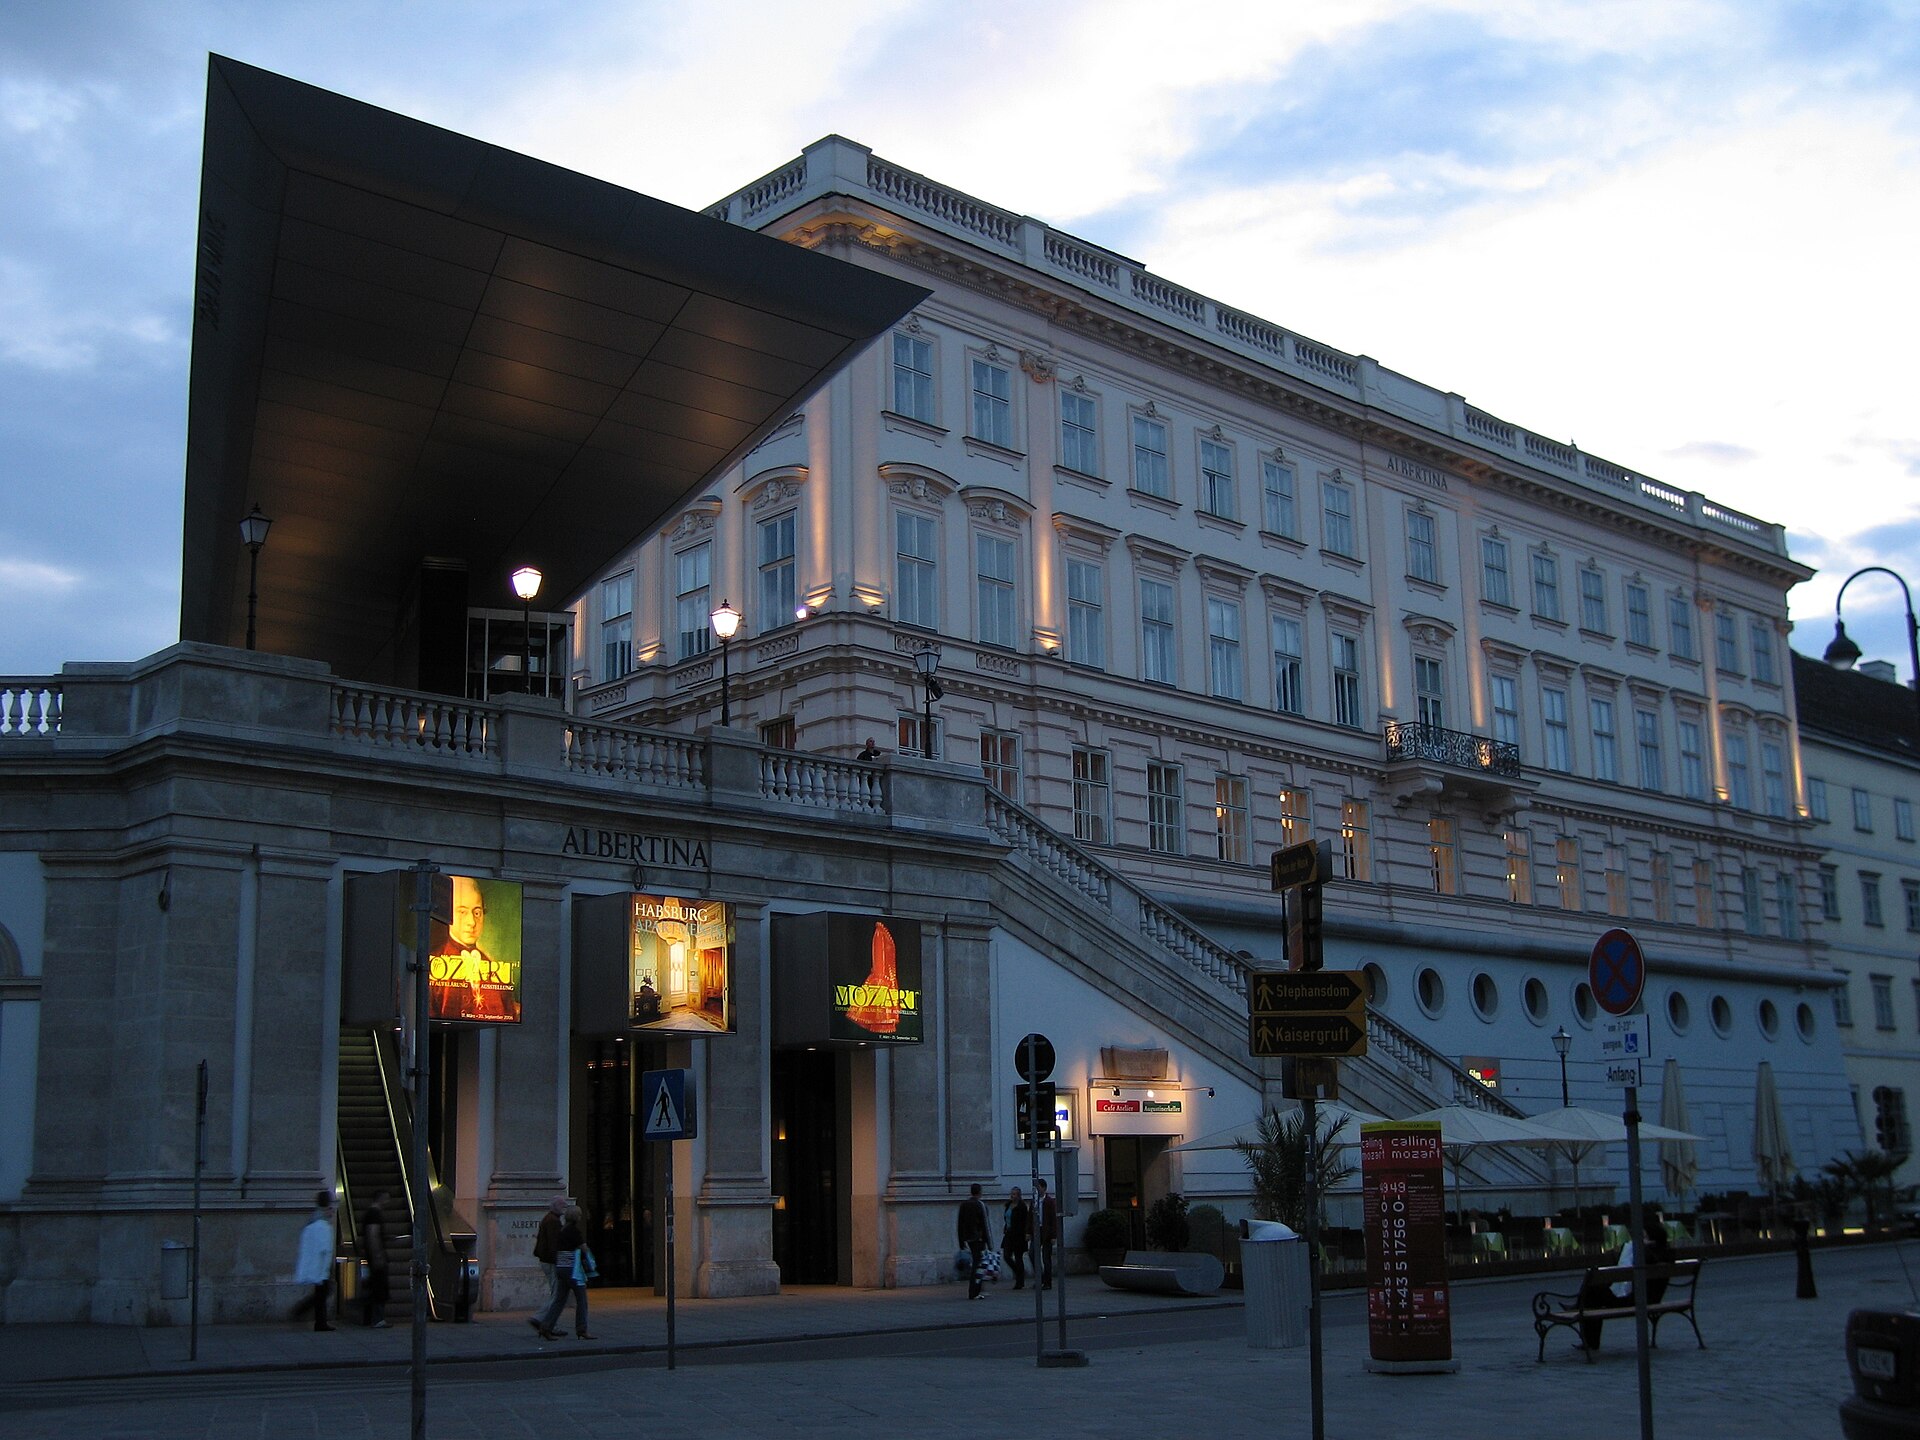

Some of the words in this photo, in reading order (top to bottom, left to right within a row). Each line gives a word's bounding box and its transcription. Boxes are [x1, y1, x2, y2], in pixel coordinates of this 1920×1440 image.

[1388, 456, 1448, 490] ALBERTINA
[562, 826, 710, 868] ALBERTINA
[634, 902, 708, 922] HABSBURG
[428, 954, 520, 985] OZART
[832, 984, 921, 1010] MOZART
[1276, 983, 1350, 1000] Stephansdom
[1275, 1026, 1350, 1046] Kaisergruft
[1607, 1066, 1635, 1084] Anfang
[1390, 1135, 1437, 1150] calling
[1391, 1149, 1441, 1159] mozart
[511, 1220, 541, 1229] ALBERTI
[1394, 1218, 1408, 1257] 1756
[1395, 1261, 1408, 1271] 5
[1396, 1276, 1409, 1308] +43
